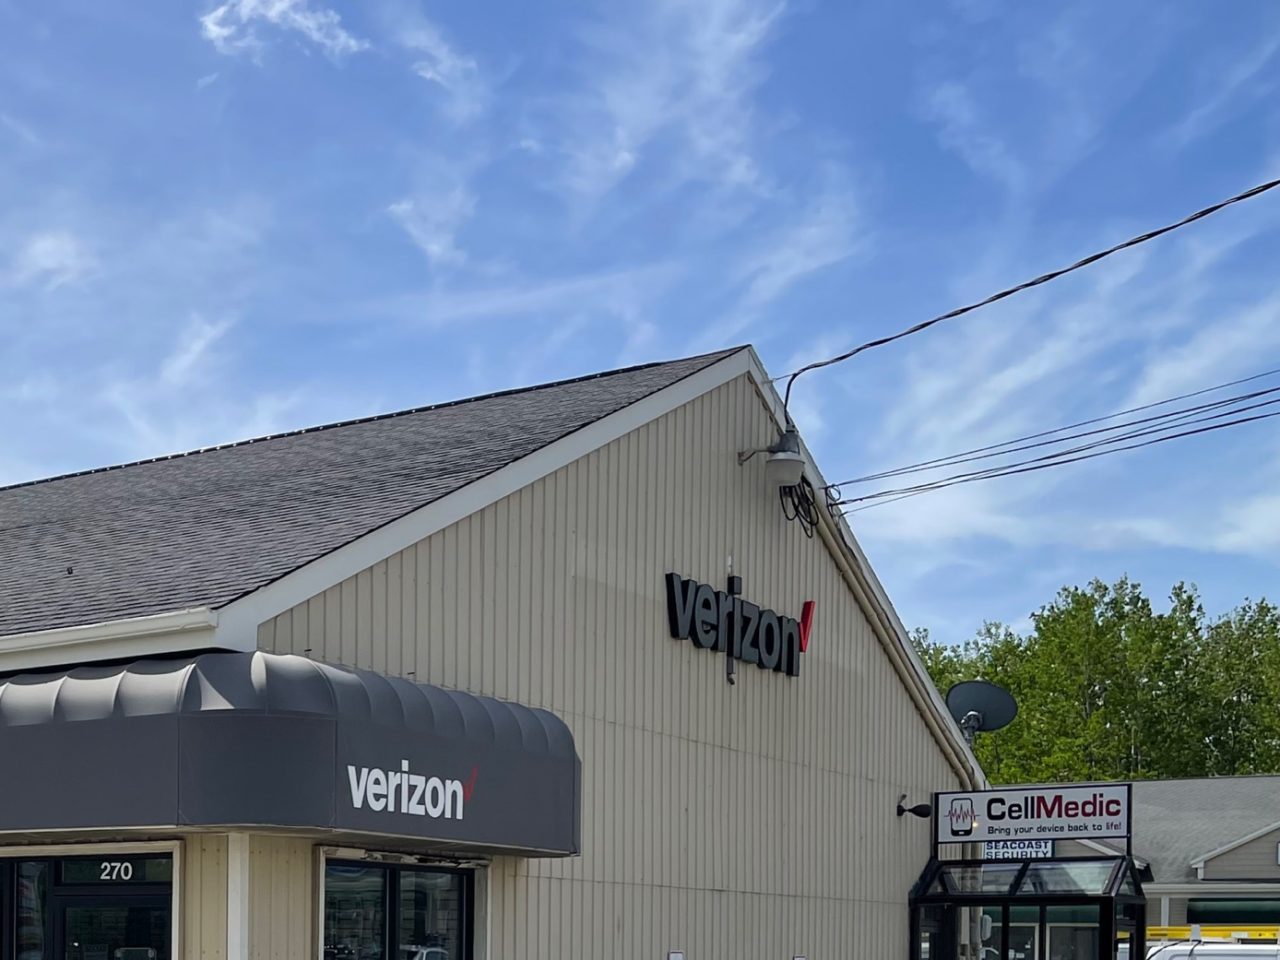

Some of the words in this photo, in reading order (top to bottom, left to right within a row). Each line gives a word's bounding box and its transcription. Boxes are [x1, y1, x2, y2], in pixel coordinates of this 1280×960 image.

[665, 572, 800, 677] verizon
[347, 759, 464, 820] verizon
[987, 793, 1121, 820] CellMedic
[987, 826, 1011, 836] Bring
[1014, 826, 1035, 836] your
[1036, 824, 1065, 834] device
[1067, 823, 1089, 832] back
[1092, 823, 1102, 831] to
[986, 840, 1050, 850] SEACOAST
[985, 850, 1049, 859] SECURITY
[100, 862, 132, 880] 270
